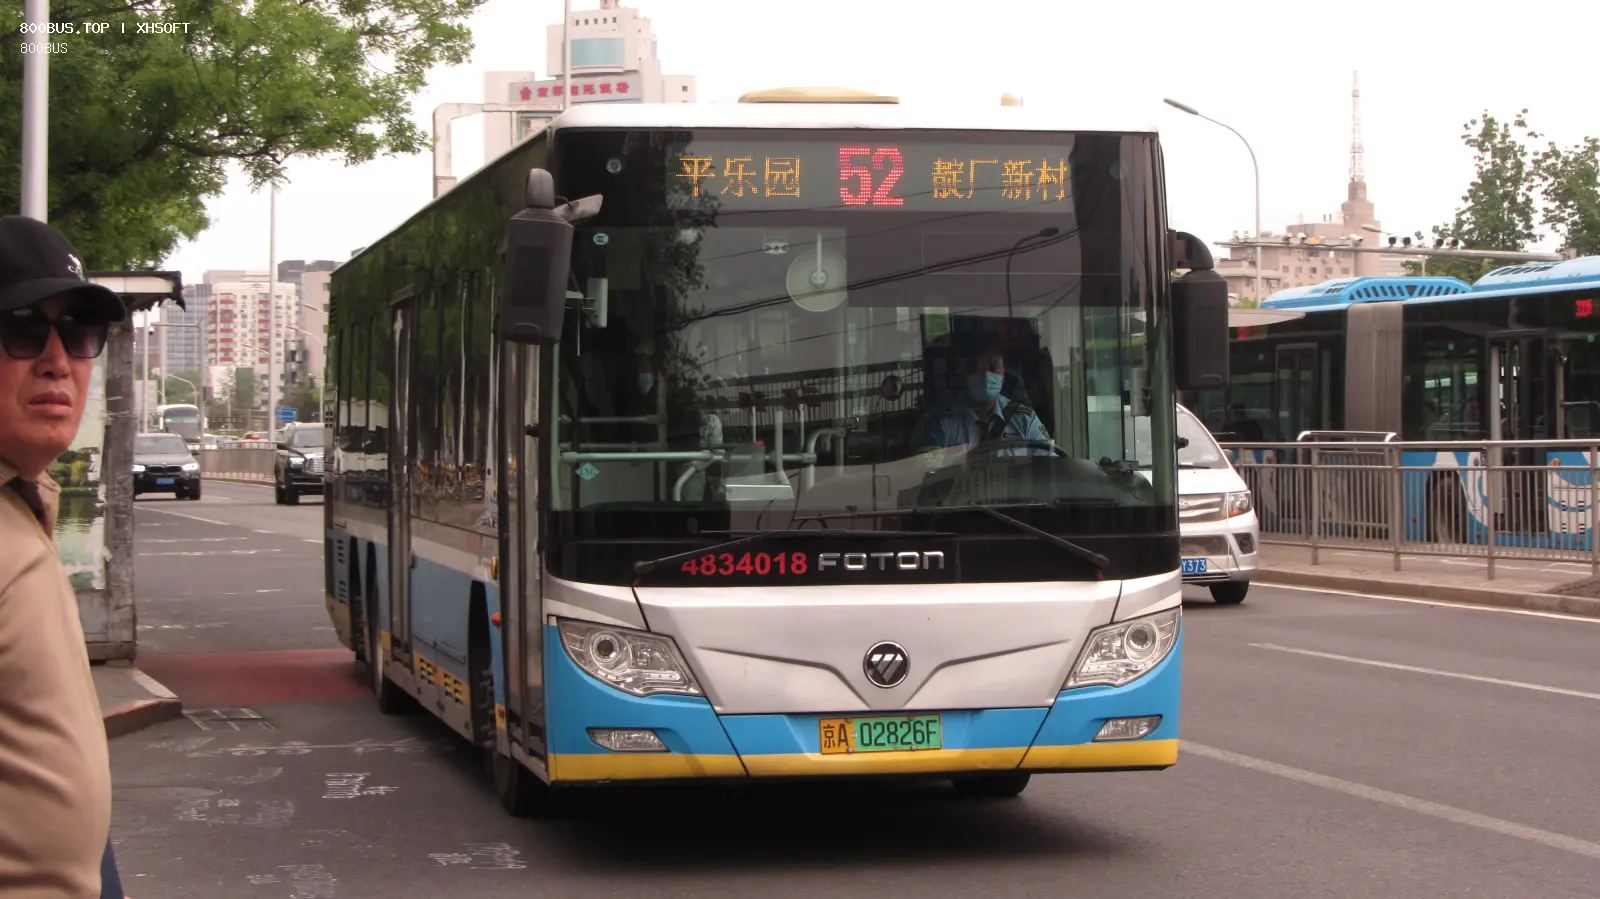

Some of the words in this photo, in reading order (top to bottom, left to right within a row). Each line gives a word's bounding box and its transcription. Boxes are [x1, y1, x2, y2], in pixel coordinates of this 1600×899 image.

[675, 155, 802, 199] 平乐园
[839, 147, 904, 206] 52
[931, 157, 1068, 201] 靛厂新村
[680, 551, 808, 576] 4834018
[817, 551, 945, 571] FOTON
[859, 719, 938, 747] 02826F
